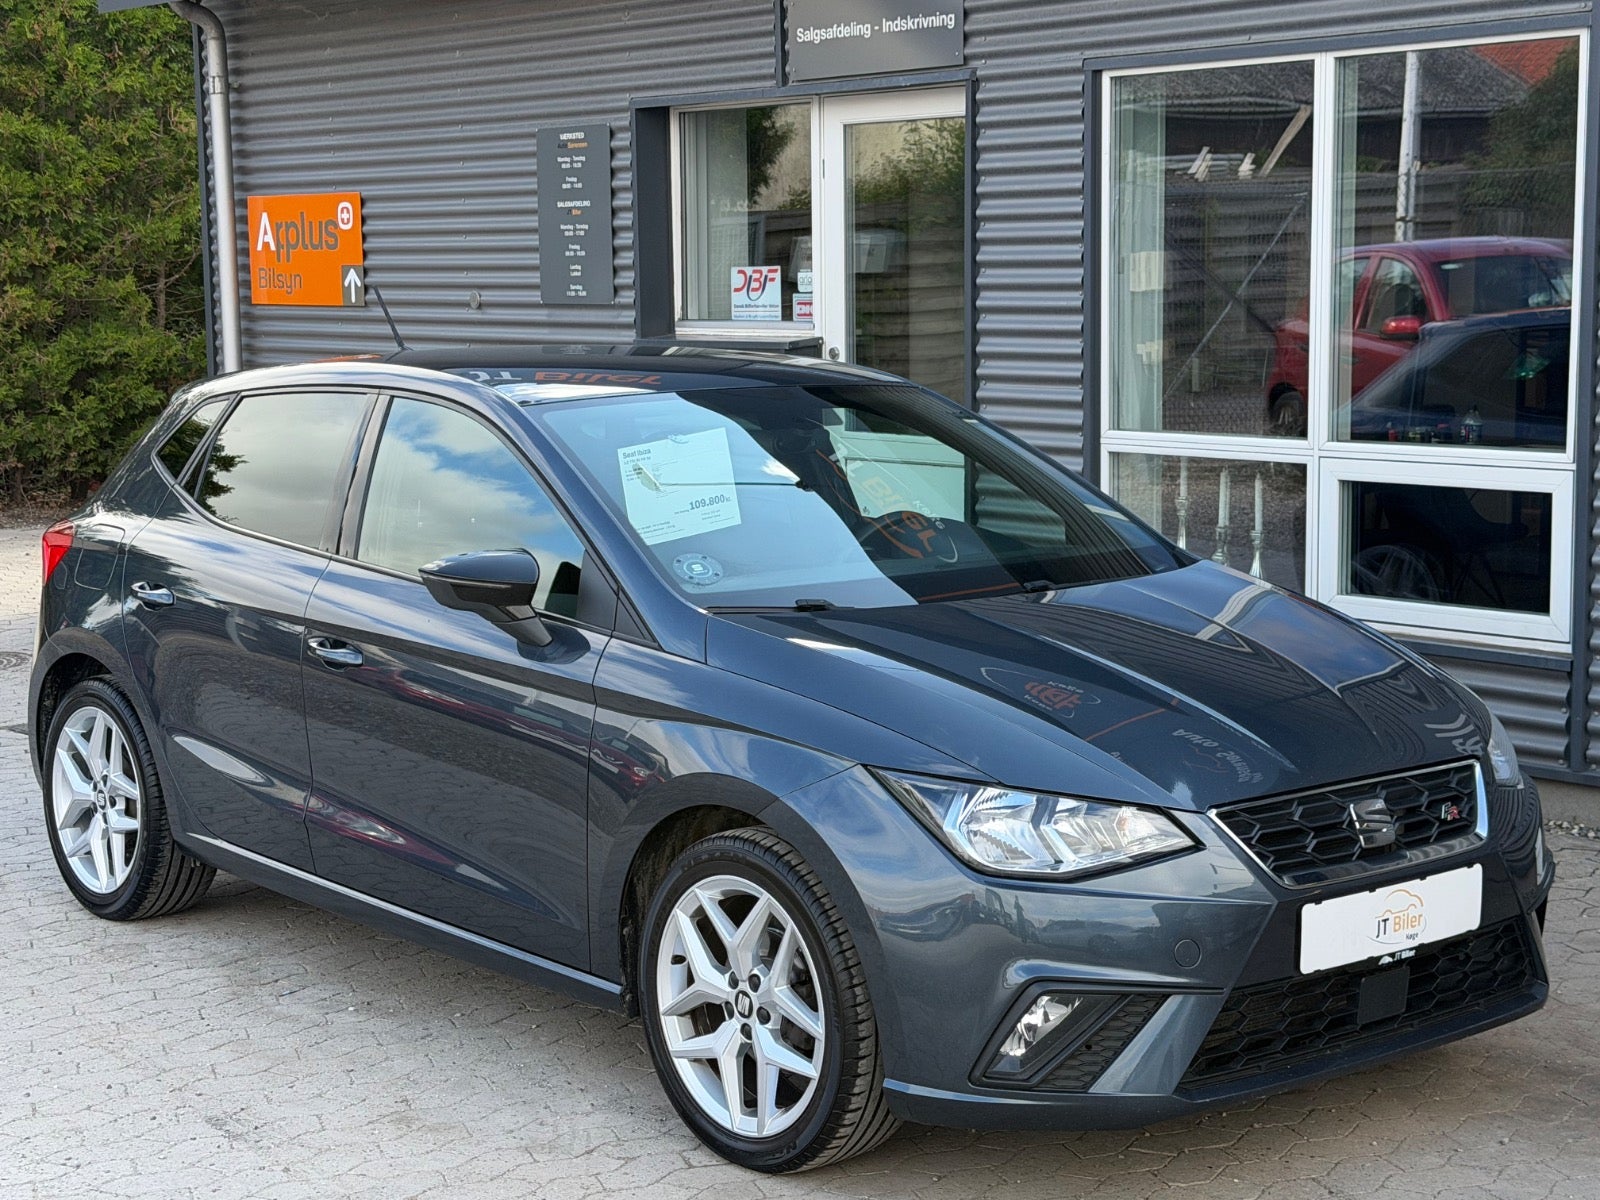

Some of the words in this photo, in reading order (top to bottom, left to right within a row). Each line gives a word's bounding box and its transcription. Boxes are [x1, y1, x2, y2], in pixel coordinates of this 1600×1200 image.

[796, 21, 871, 44] Salgsafdeling
[882, 11, 955, 33] Indskrivning
[258, 267, 303, 295] Bilsyn
[622, 449, 637, 460] Seat
[688, 494, 725, 511] 109.800
[1441, 801, 1460, 821] FR
[1375, 917, 1390, 939] JT
[1392, 912, 1424, 934] Biler
